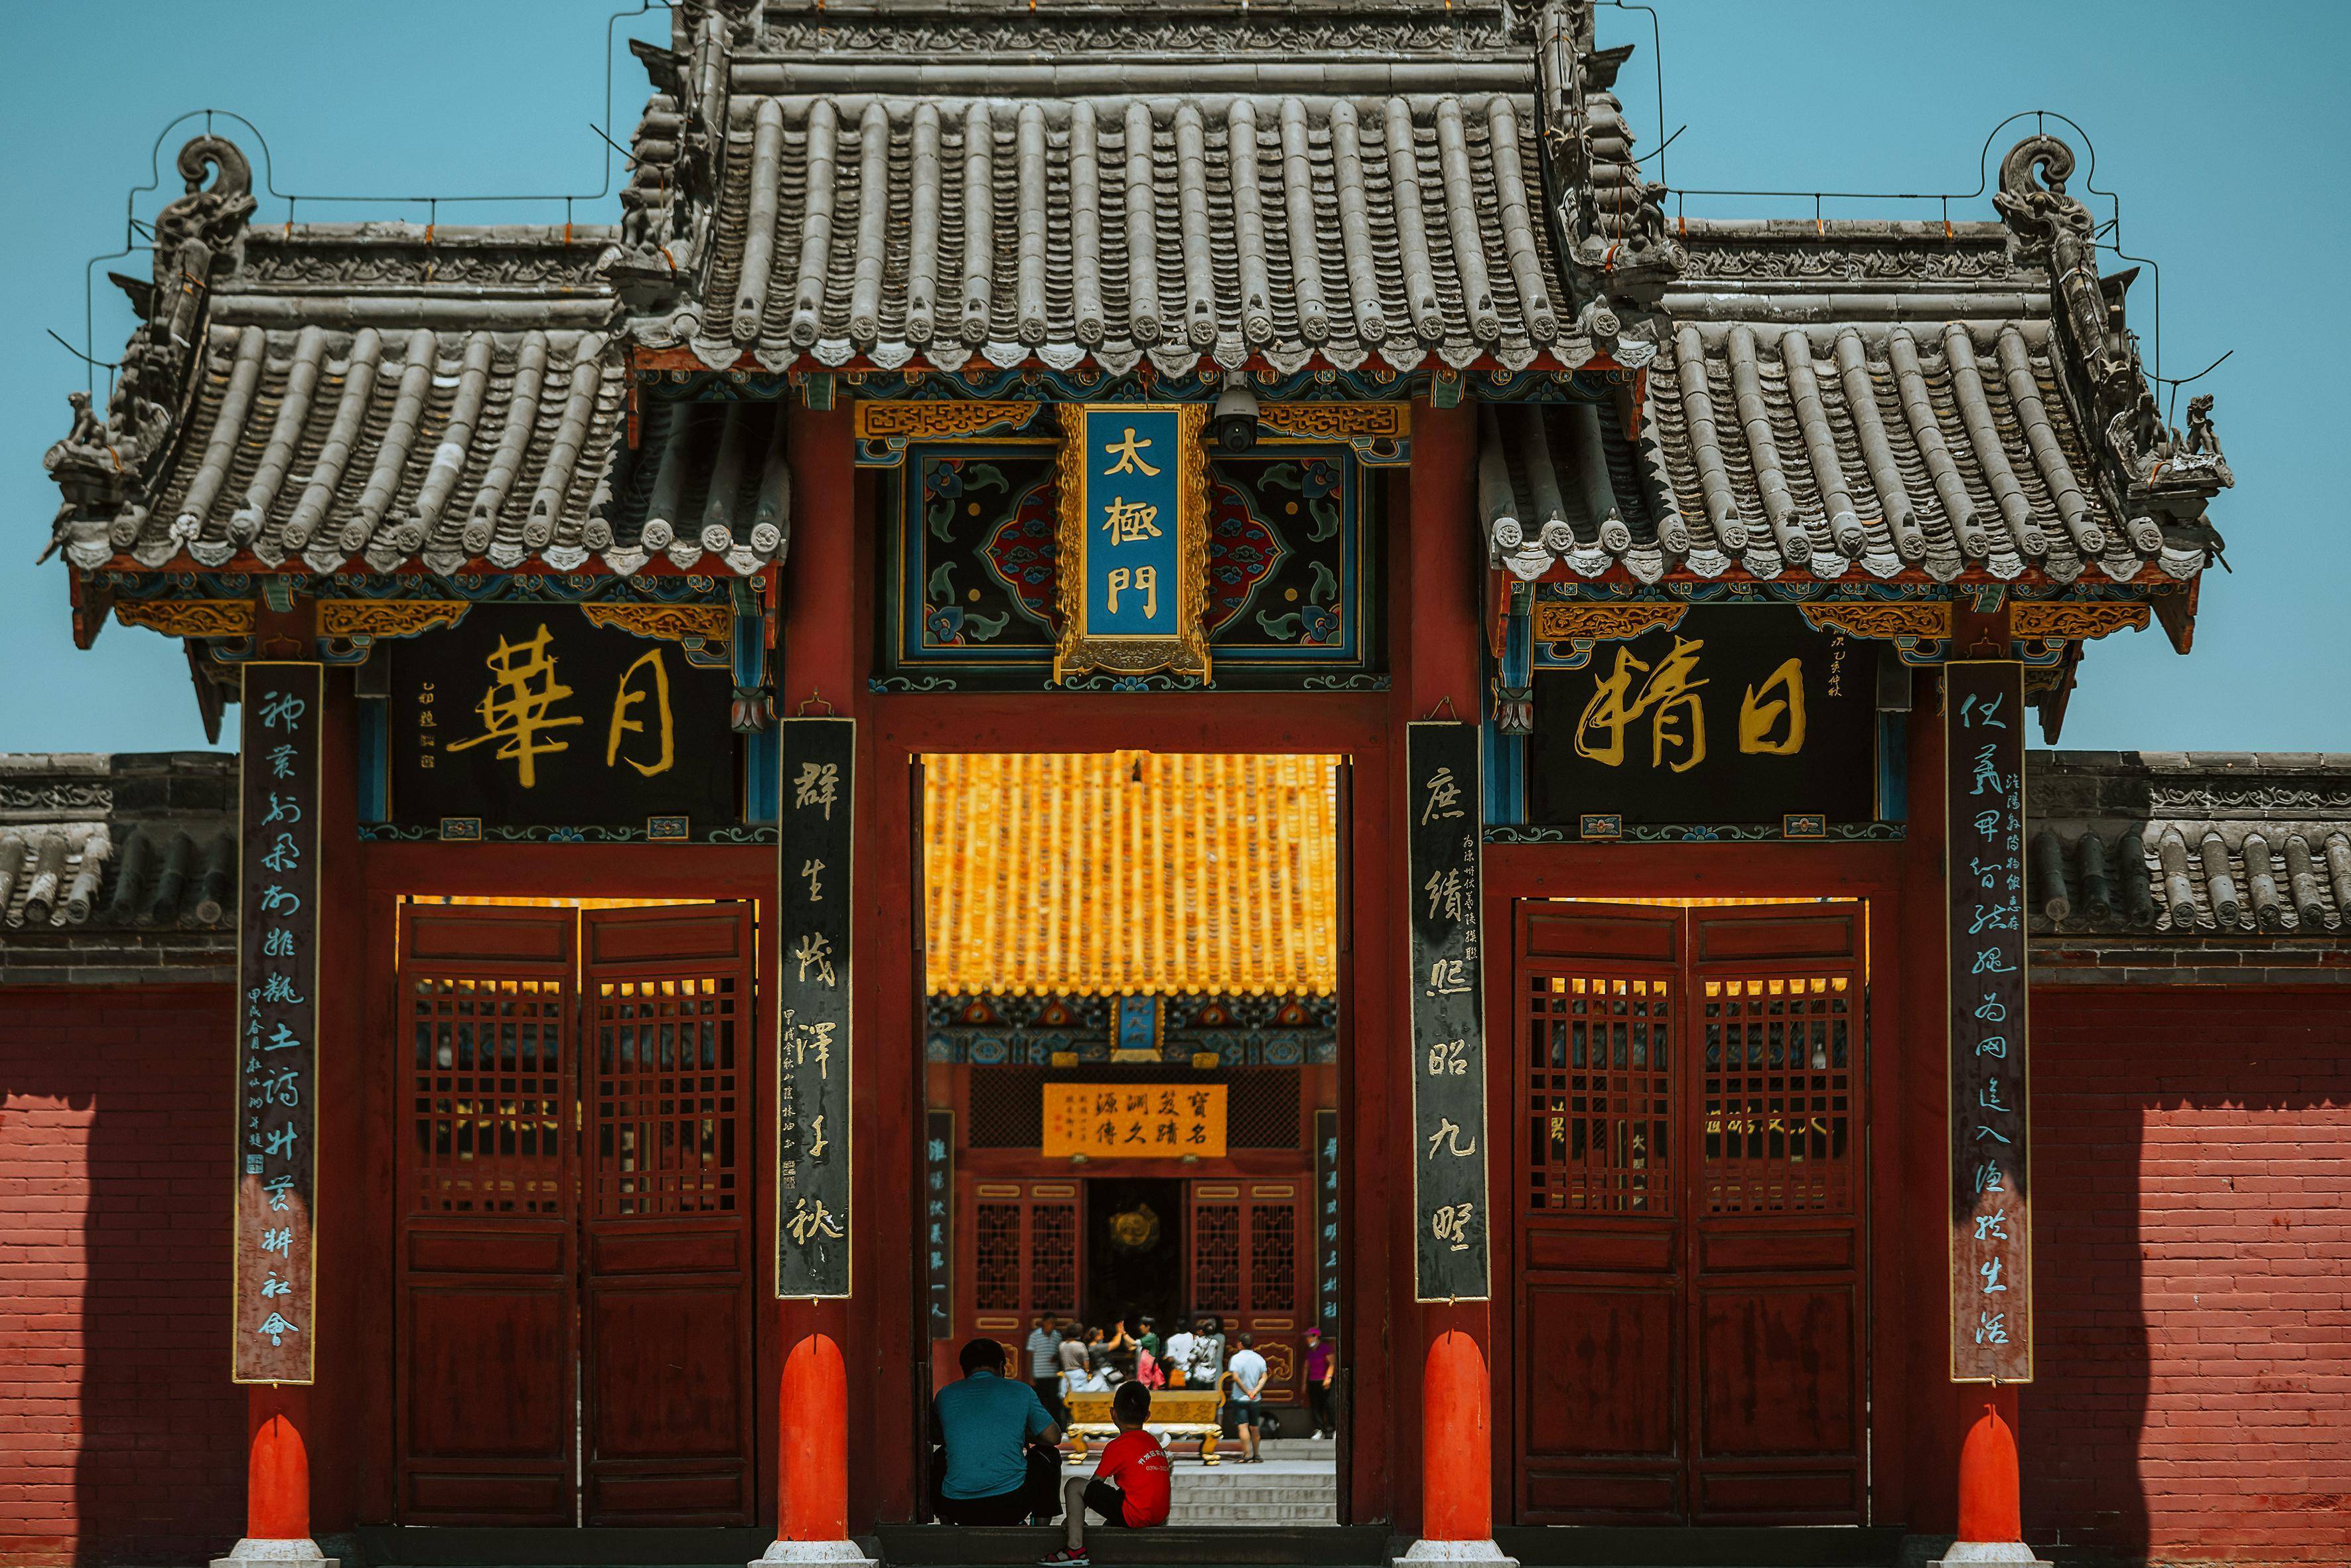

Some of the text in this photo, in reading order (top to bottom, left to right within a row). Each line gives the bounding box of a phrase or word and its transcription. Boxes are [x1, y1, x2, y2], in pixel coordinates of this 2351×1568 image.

[1102, 427, 1163, 620] 太極門
[447, 623, 675, 788] 月華
[1574, 634, 1806, 774] 日精
